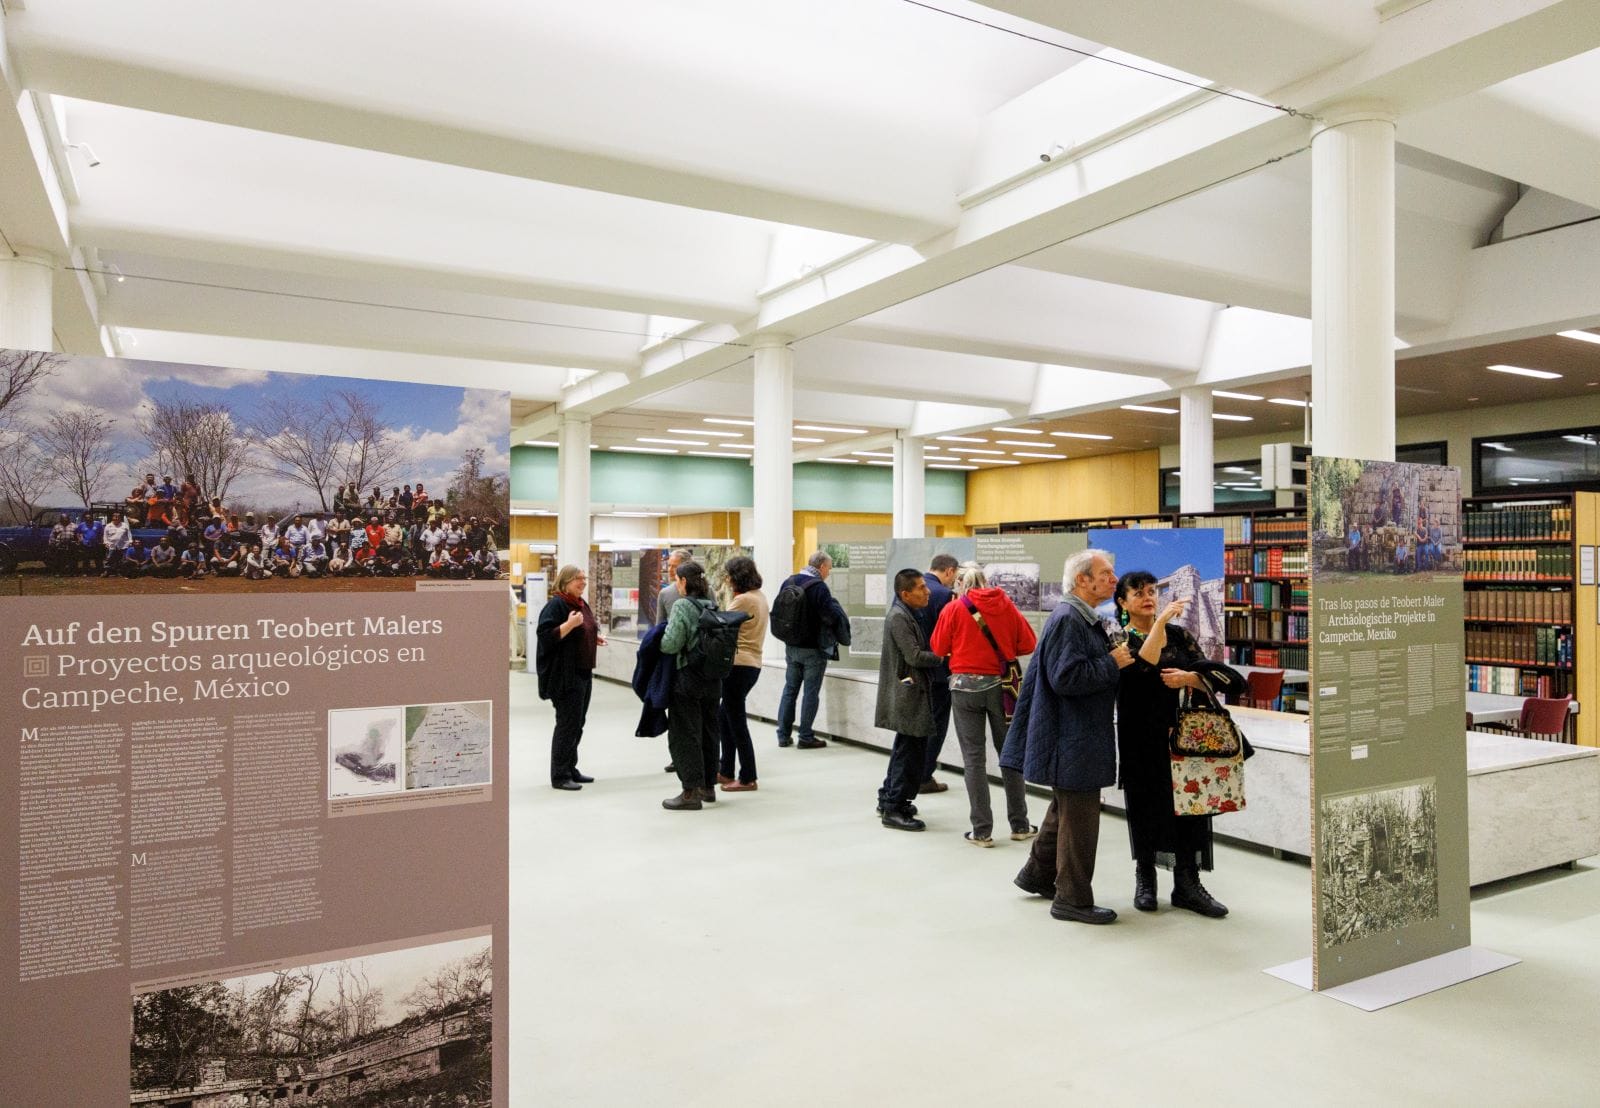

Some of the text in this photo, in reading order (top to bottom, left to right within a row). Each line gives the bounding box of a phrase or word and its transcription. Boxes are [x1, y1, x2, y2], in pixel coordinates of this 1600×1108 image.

[1319, 594, 1445, 613] Tras los pasos de Teobert Maler
[21, 615, 443, 648] Auf den Spuren Teobert Malers
[1328, 610, 1436, 628] Archäologische Projekte in
[1319, 627, 1397, 646] Campeche, Mexiko
[57, 644, 426, 681] Proyectos arqueológicos en
[22, 678, 290, 712] Campeche, México
